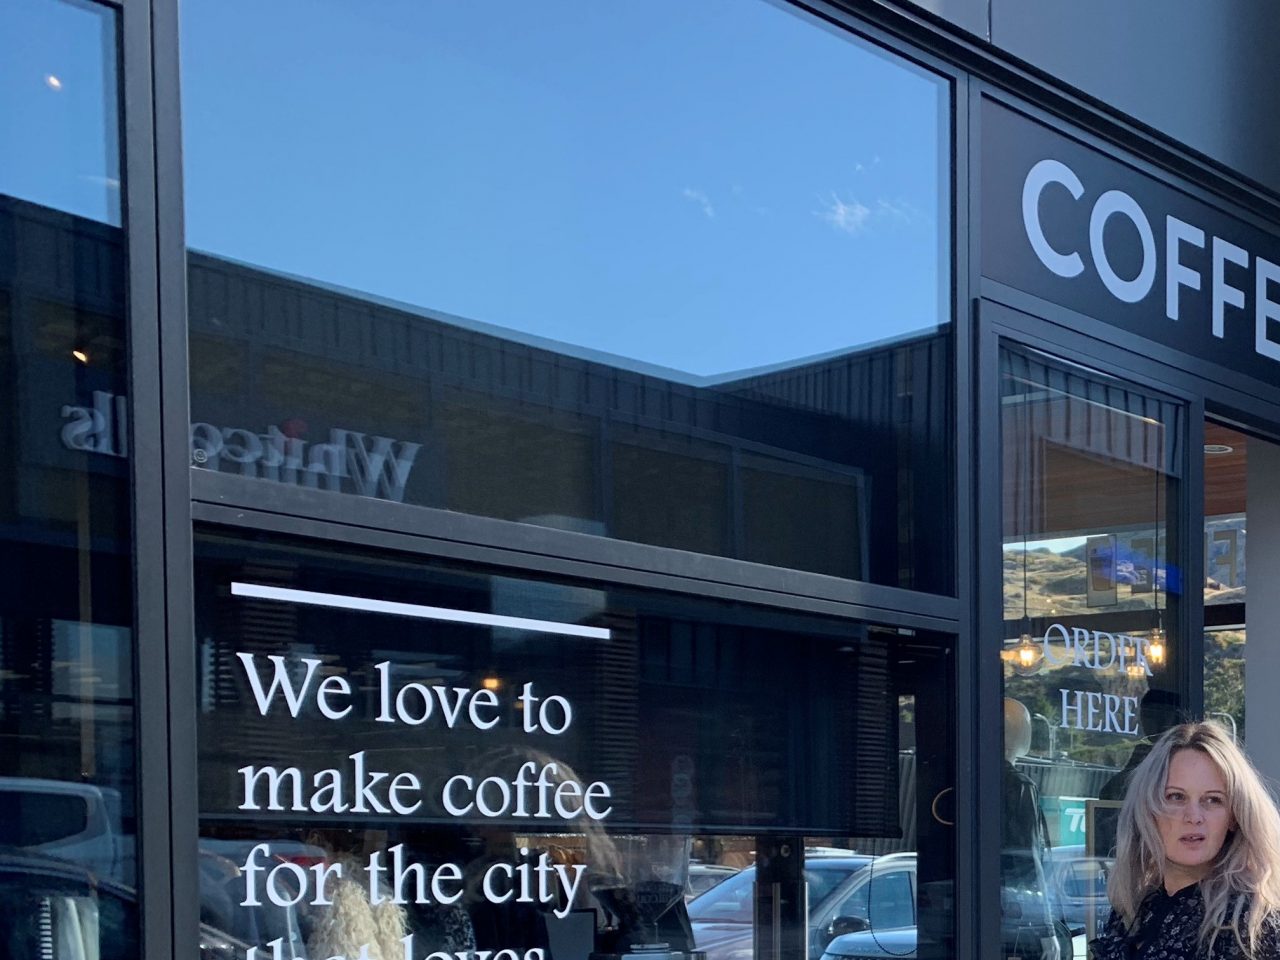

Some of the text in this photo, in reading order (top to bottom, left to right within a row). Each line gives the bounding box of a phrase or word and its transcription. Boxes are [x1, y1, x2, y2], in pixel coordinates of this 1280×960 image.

[1043, 623, 1154, 677] ORDER
[236, 652, 573, 735] We love to
[1059, 688, 1139, 736] HERE
[237, 751, 612, 819] make coffee
[239, 844, 587, 918] for the city
